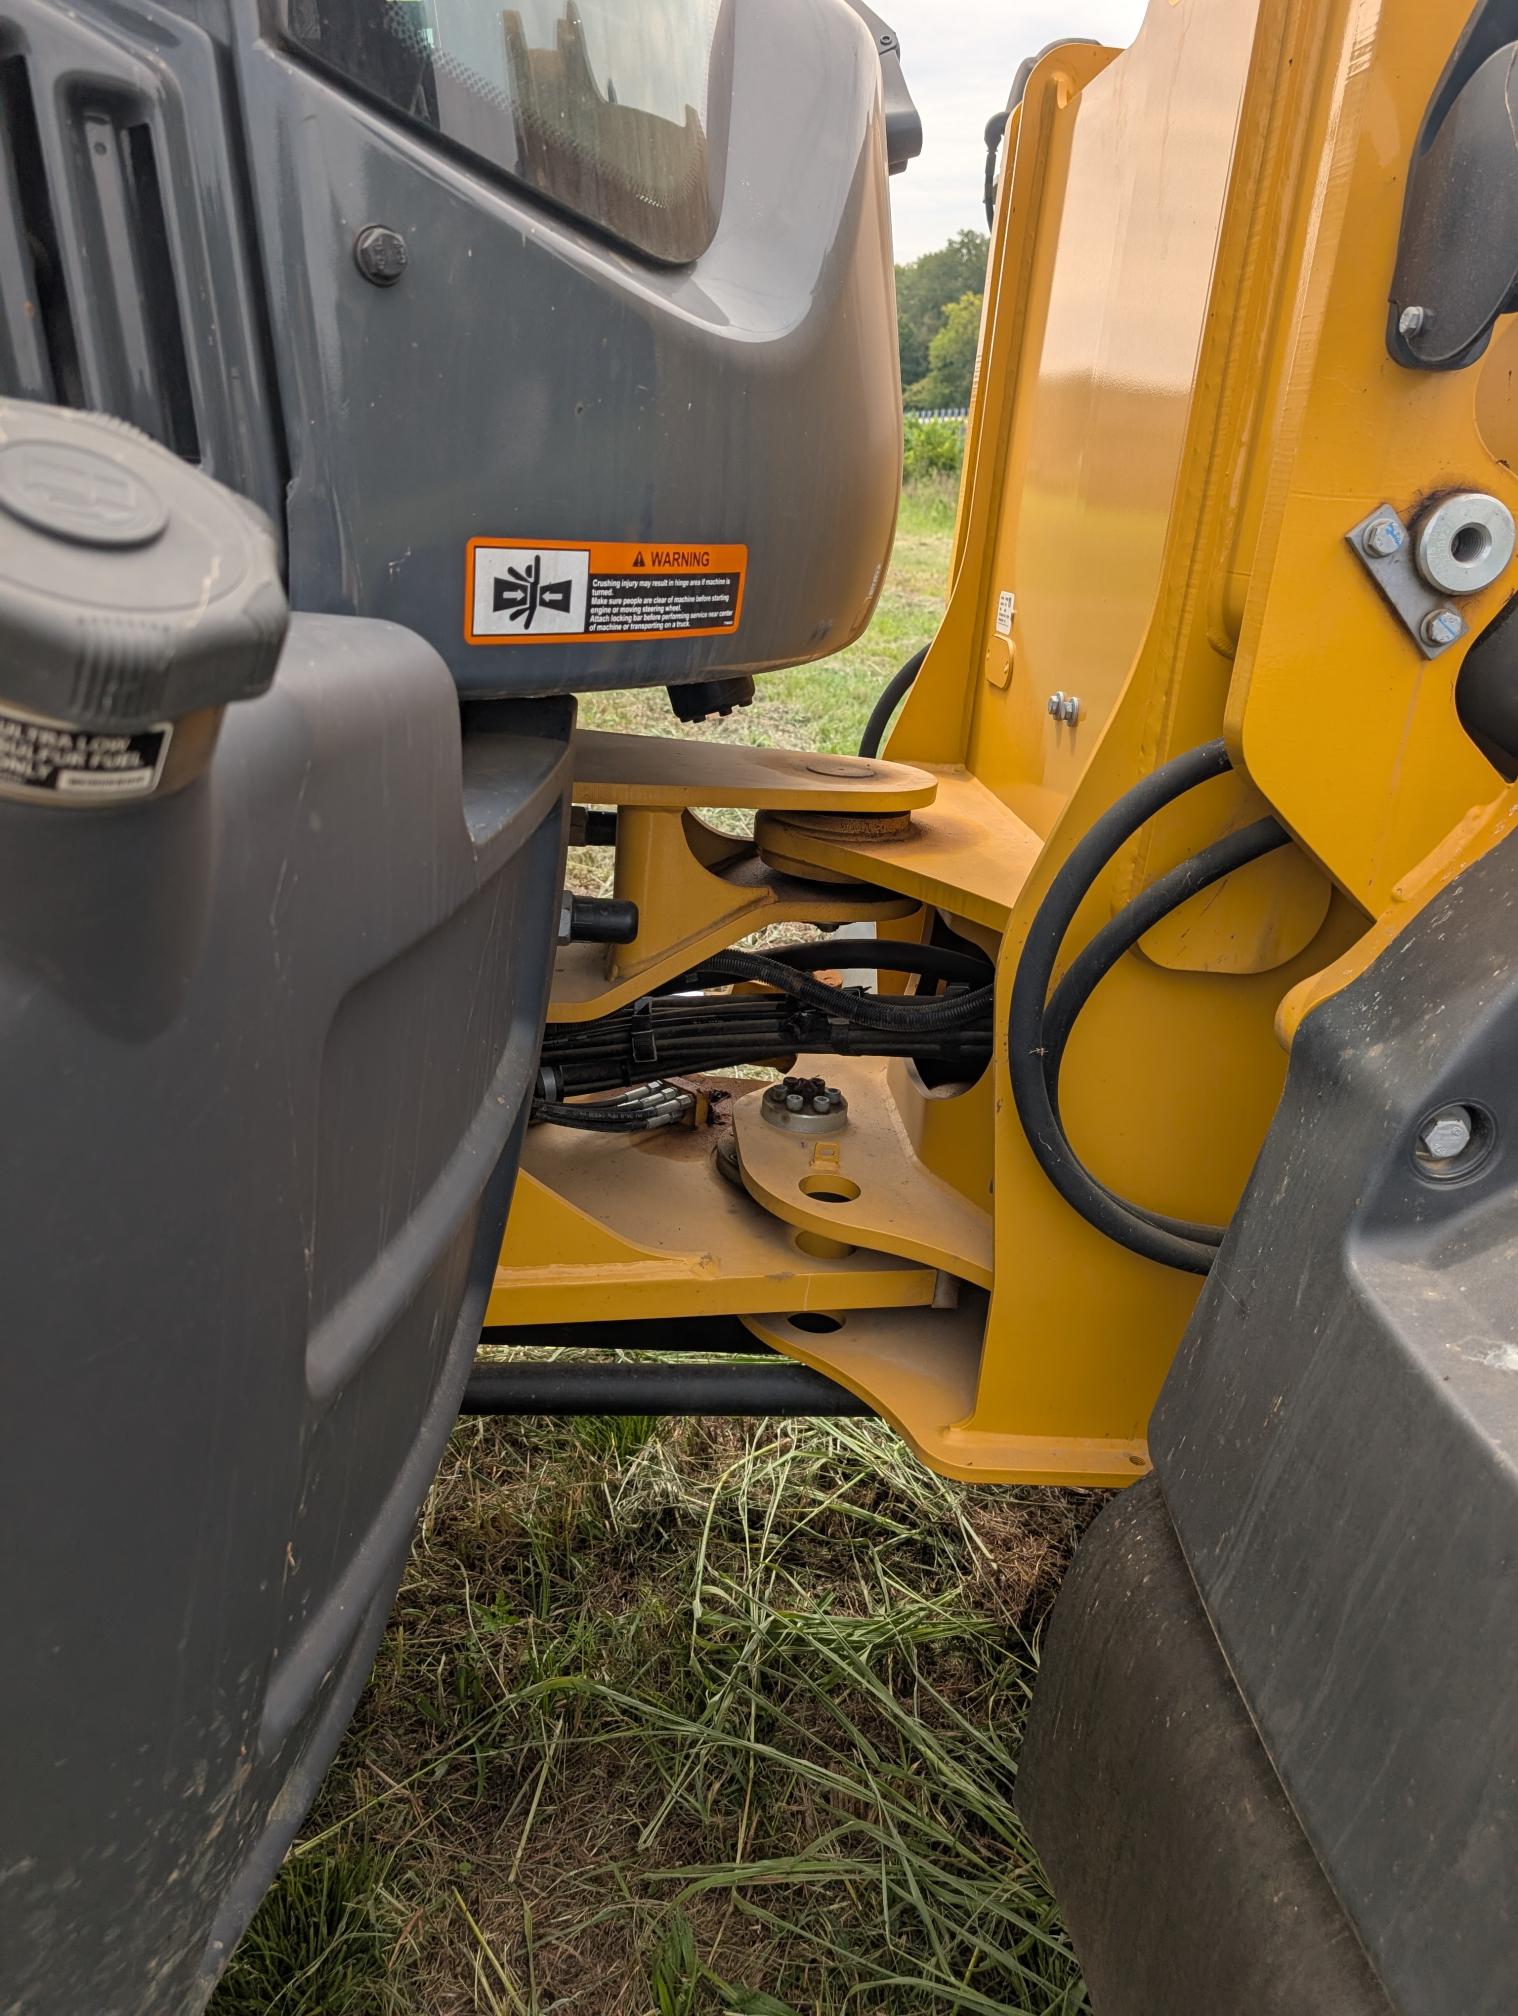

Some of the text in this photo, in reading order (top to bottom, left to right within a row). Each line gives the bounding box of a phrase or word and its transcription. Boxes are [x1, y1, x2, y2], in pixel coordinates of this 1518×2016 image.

[651, 552, 710, 567] WARNING
[592, 579, 620, 588] Crushing
[622, 579, 638, 588] injury
[675, 579, 689, 588] hinge
[623, 597, 642, 606] people
[712, 594, 730, 602] starting
[590, 606, 611, 615] engine
[620, 606, 641, 614] moving
[642, 605, 664, 614] steering
[611, 615, 632, 623] locking
[661, 613, 689, 622] performing
[630, 622, 663, 631] transporting
